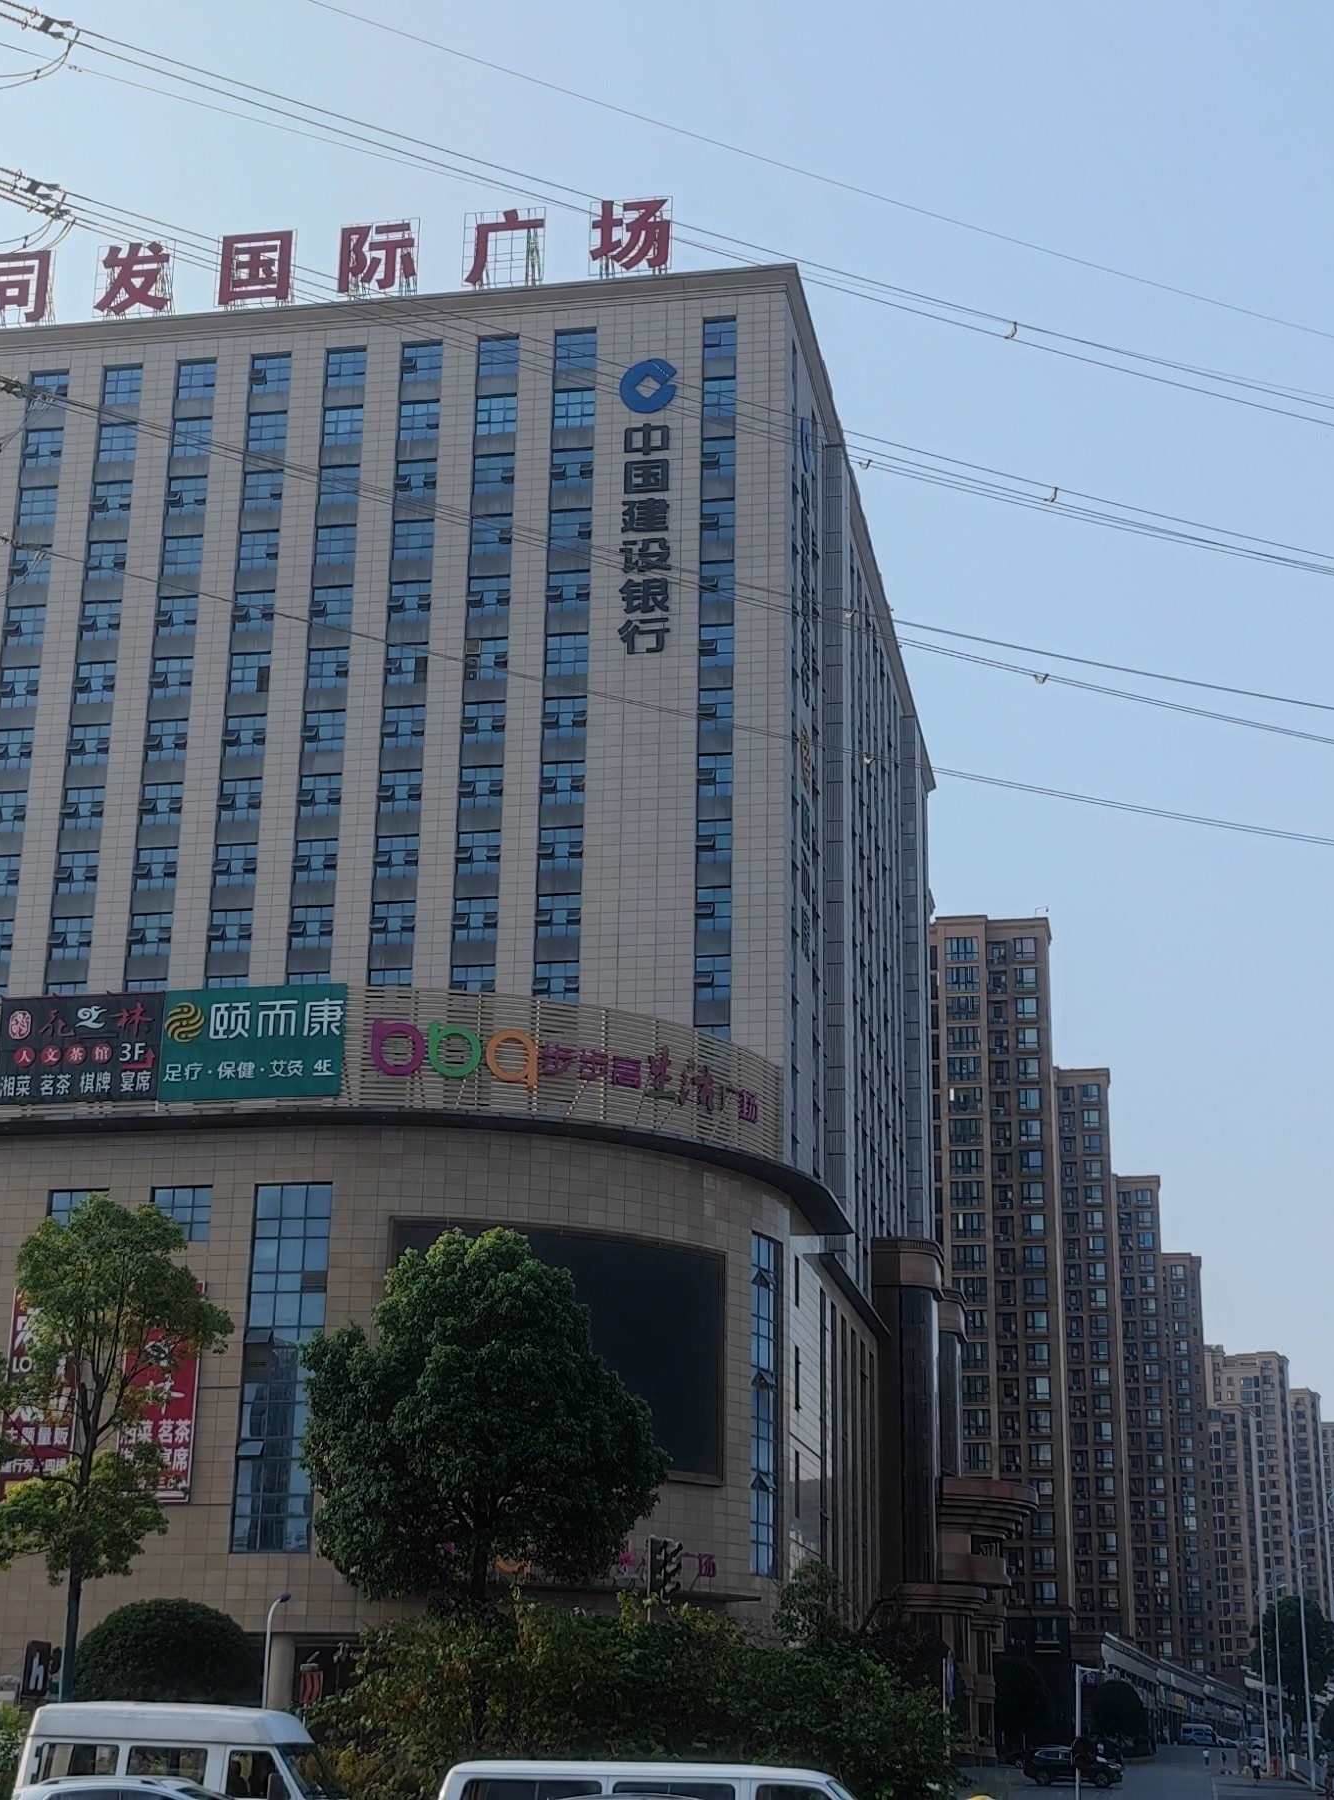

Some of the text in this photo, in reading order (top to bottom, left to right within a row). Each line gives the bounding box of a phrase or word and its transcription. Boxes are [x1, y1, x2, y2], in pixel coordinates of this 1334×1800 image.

[618, 422, 672, 655] 中国建设银行
[209, 999, 344, 1040] 颐而康
[16, 1042, 147, 1063] 人文茶馆 3F
[40, 1073, 72, 1096] 茗茶
[80, 1071, 112, 1094] 棋牌
[120, 1070, 152, 1093] 宴席
